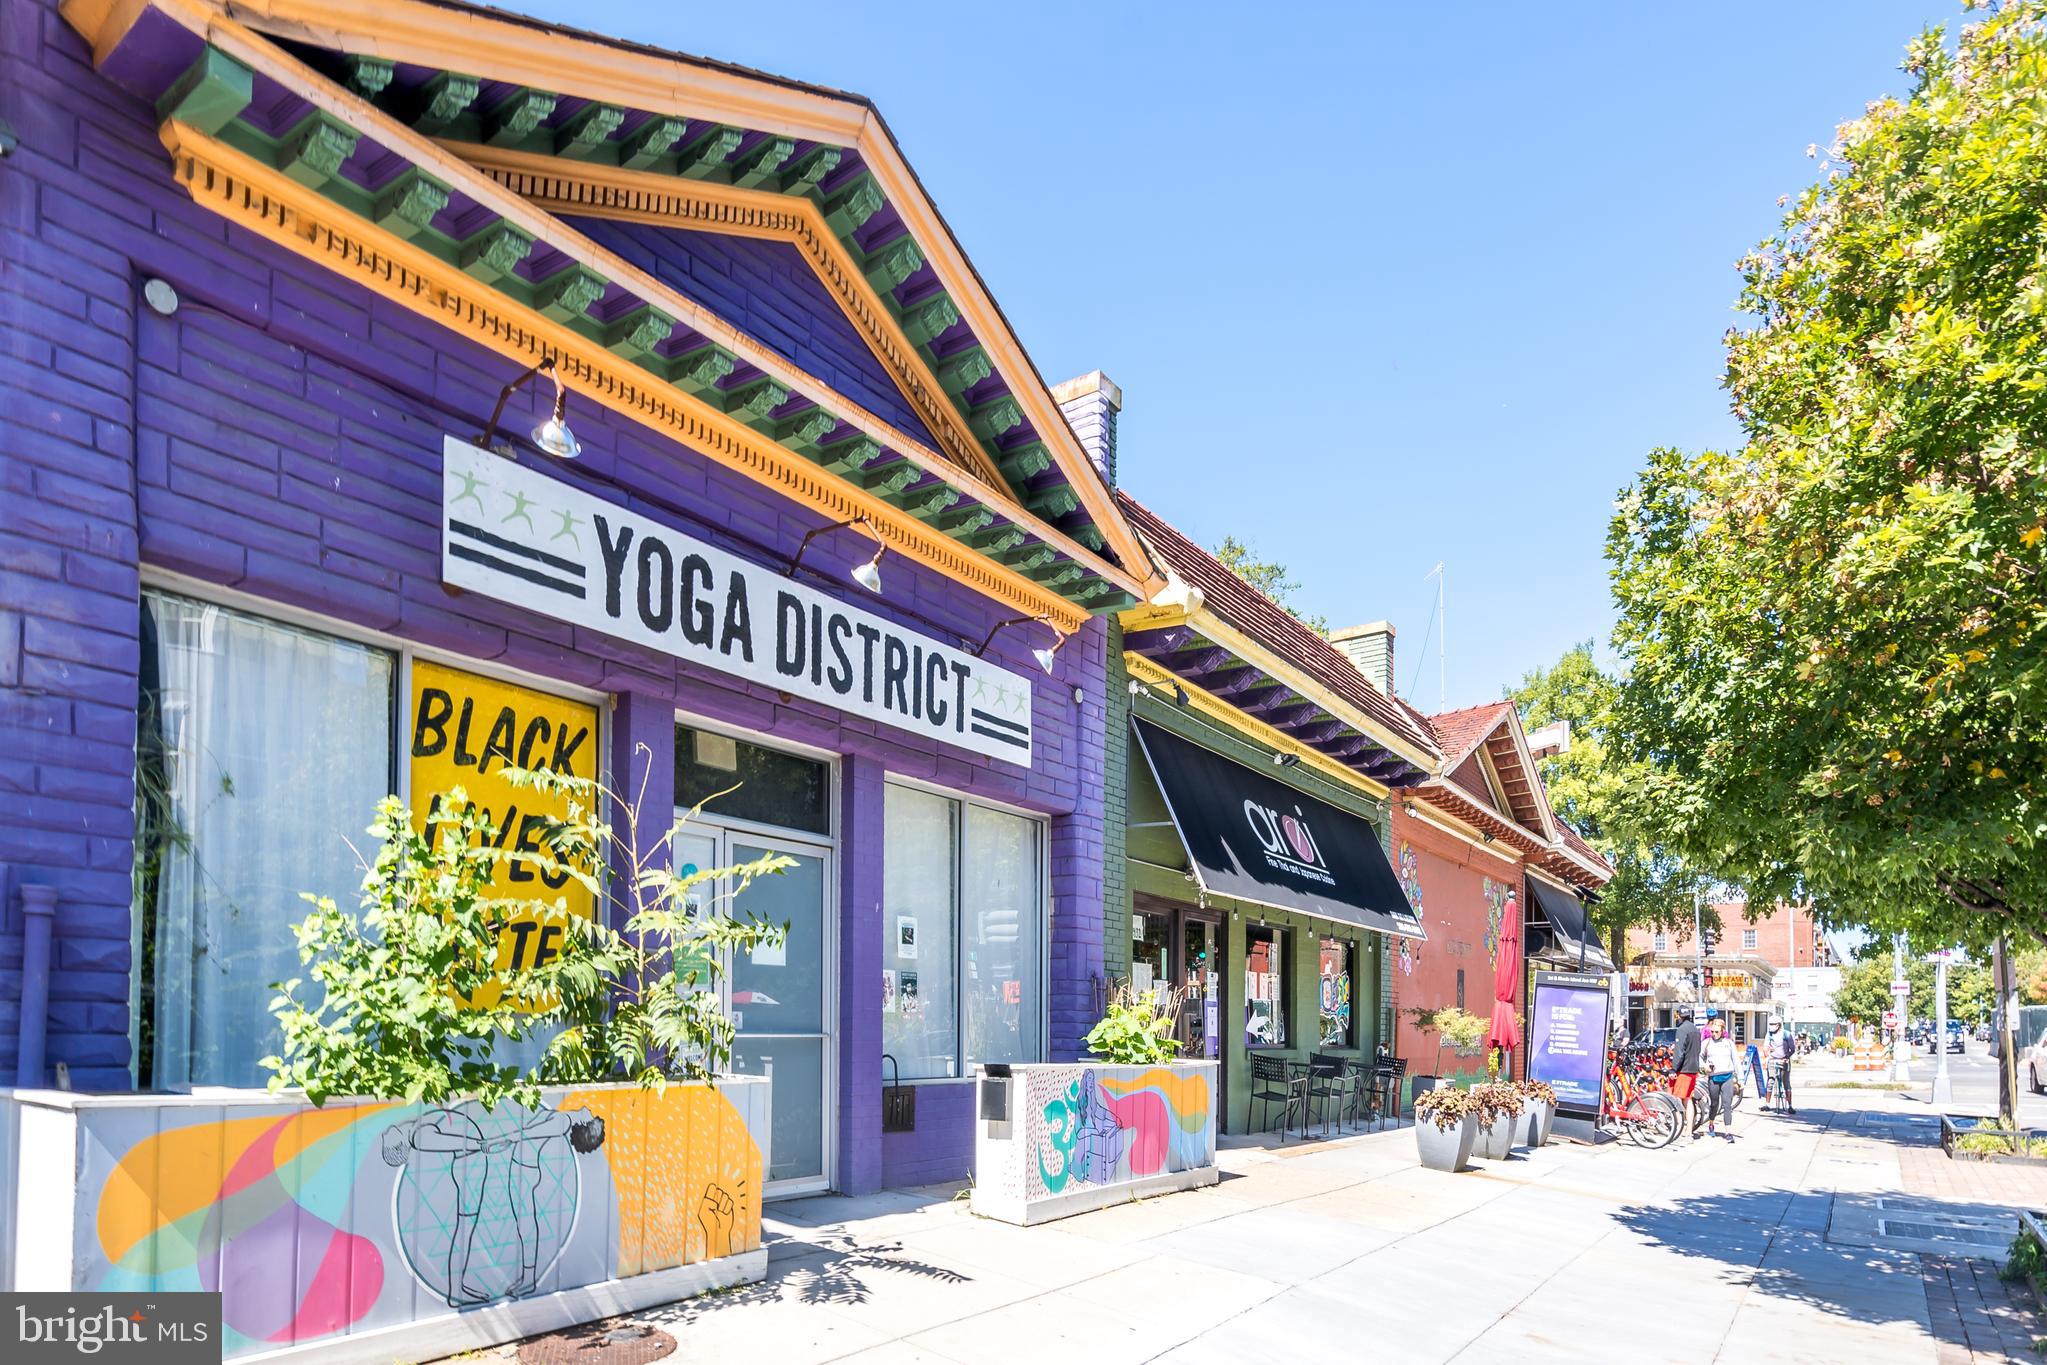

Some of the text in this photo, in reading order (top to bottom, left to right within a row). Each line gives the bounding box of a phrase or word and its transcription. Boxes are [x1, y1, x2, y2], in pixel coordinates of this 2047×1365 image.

[593, 514, 971, 734] YOGA DISTRICT
[412, 688, 589, 787] BLACK
[1244, 799, 1327, 868] aroi
